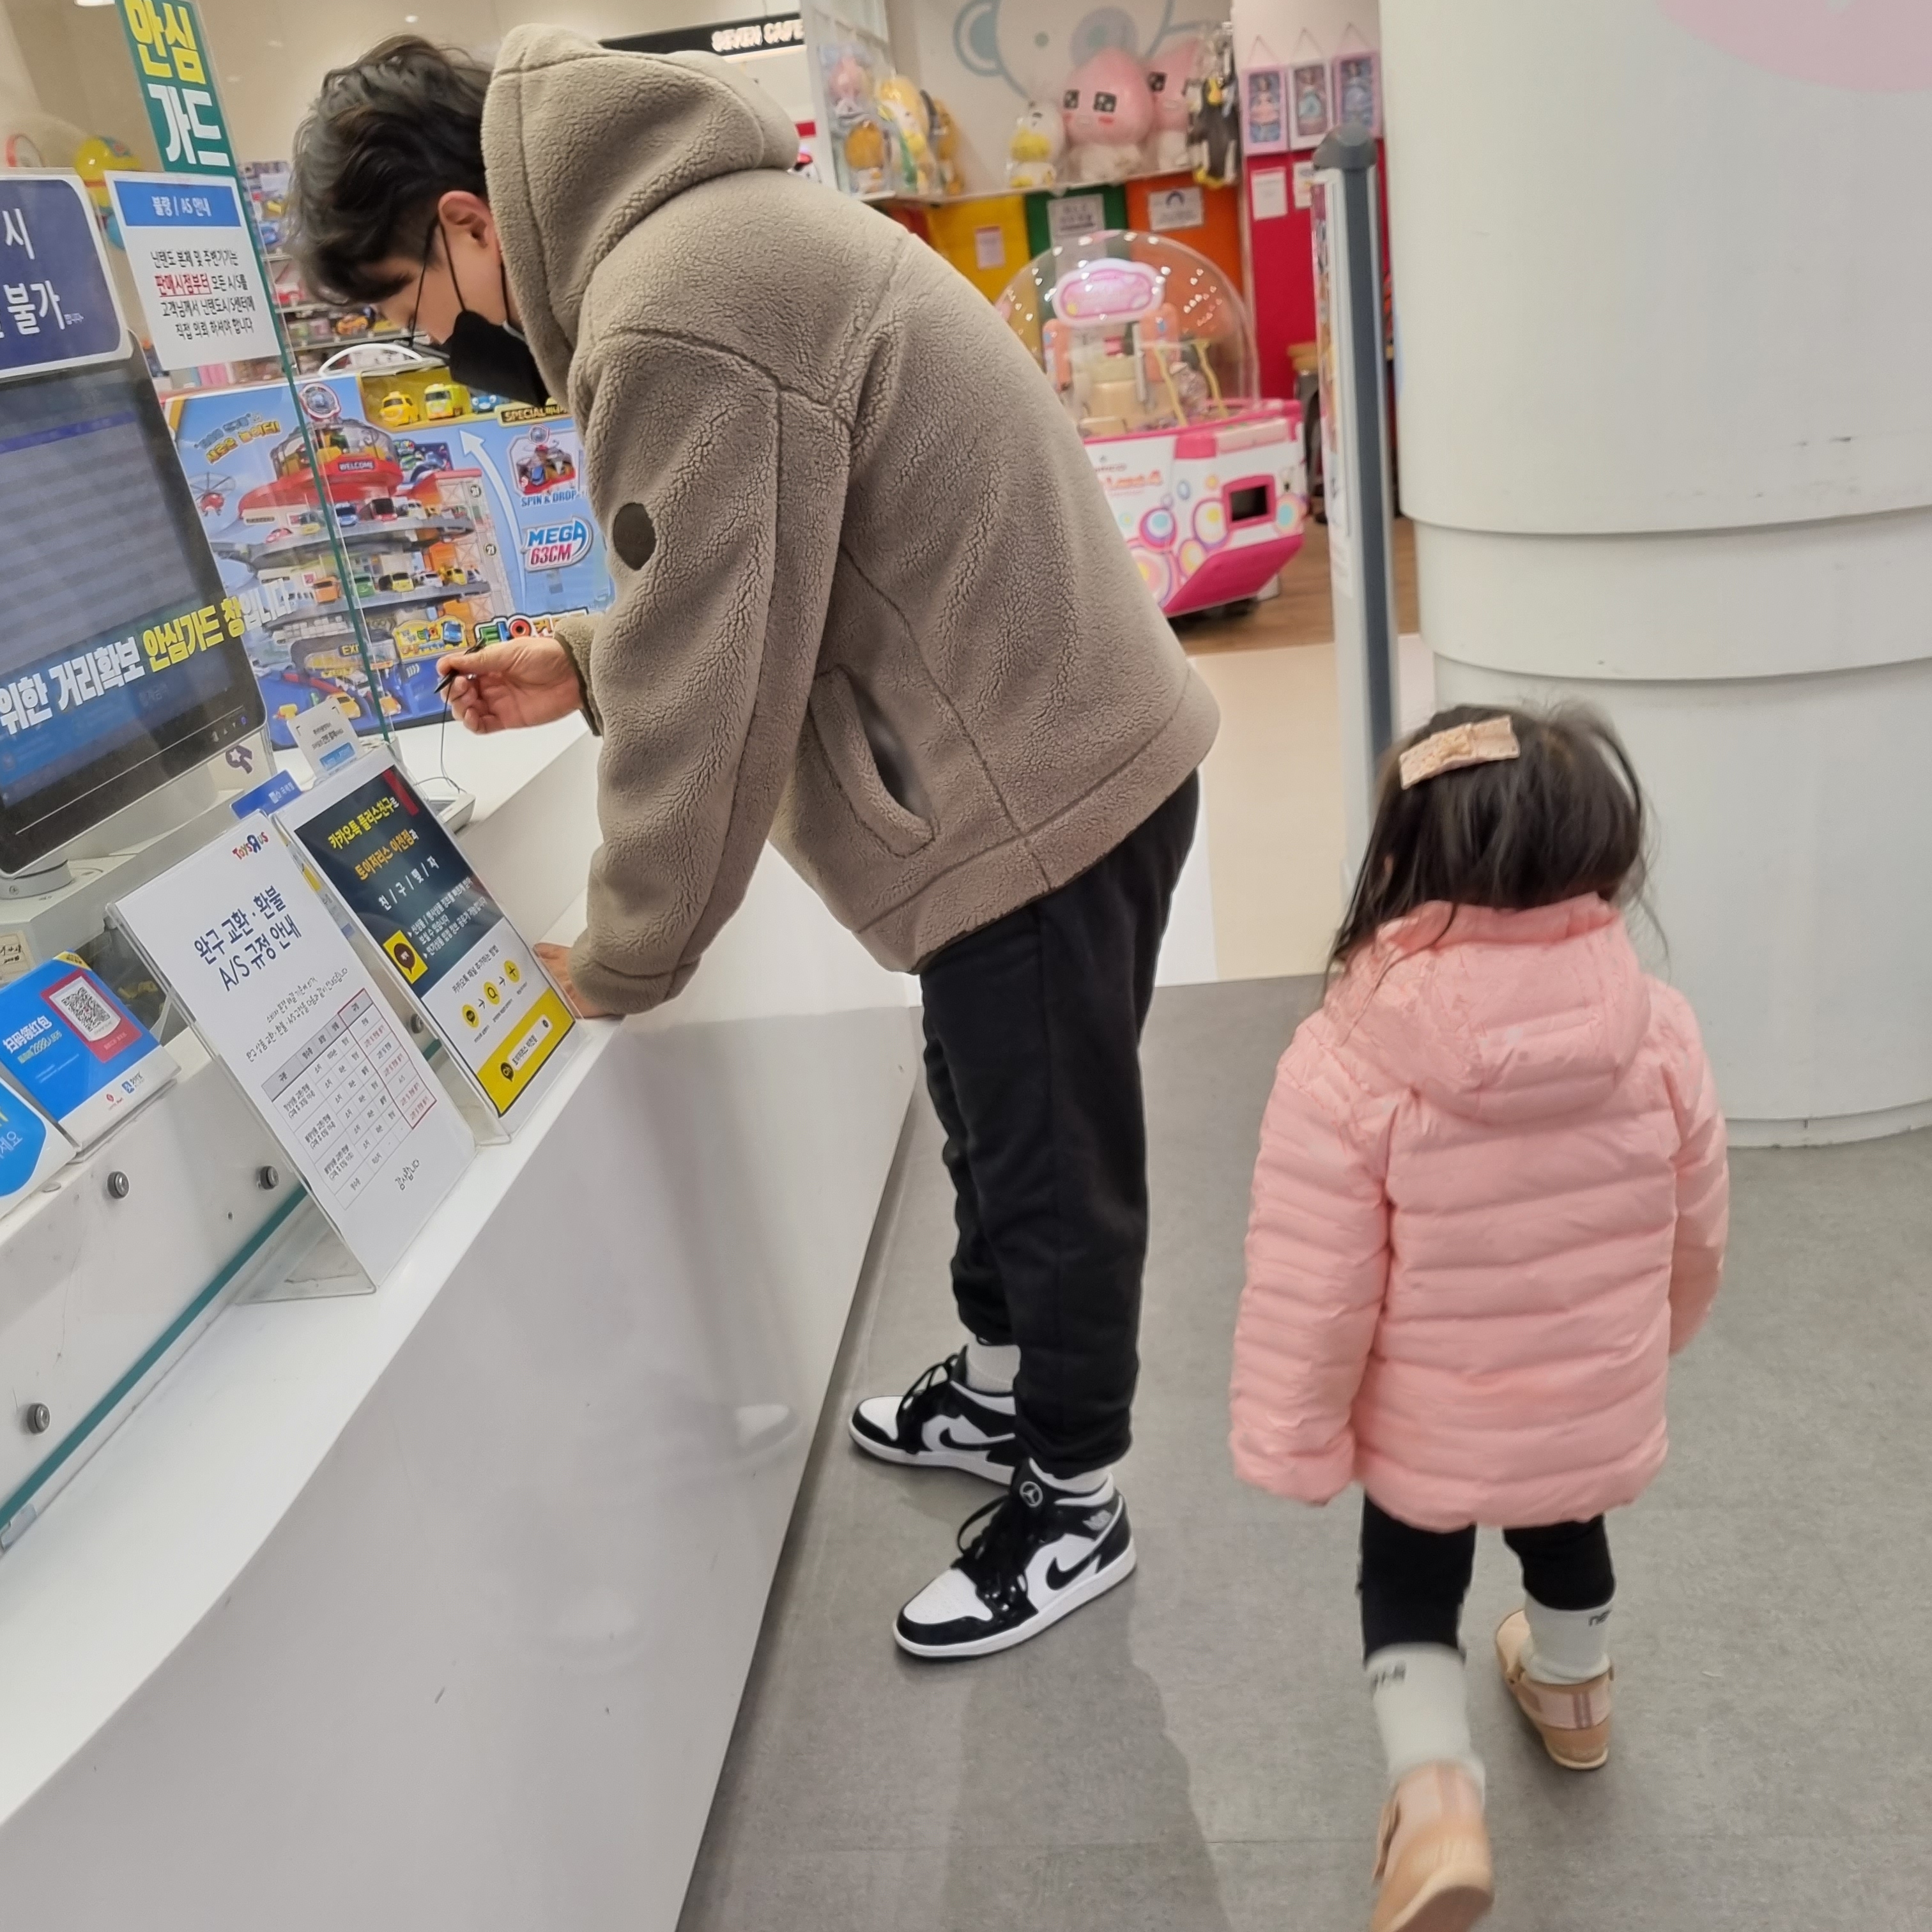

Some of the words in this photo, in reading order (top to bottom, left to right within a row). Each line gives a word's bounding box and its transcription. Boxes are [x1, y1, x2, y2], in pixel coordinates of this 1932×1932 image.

[125, 0, 207, 84] 안심
[711, 25, 762, 52] SEVEN
[148, 83, 231, 167] 가드
[151, 251, 176, 268] 닌텐도
[193, 250, 203, 266] 및
[155, 274, 210, 295] 판매시점부터
[211, 275, 226, 291] 모든
[161, 300, 199, 317] 고객님께서
[175, 323, 192, 339] 직접
[210, 319, 231, 334] 하셔야
[232, 318, 252, 334] 합니다
[505, 407, 546, 422] SPECIAL
[339, 460, 374, 471] WELCOME
[521, 494, 542, 507] SPIN
[552, 490, 577, 503] DROP
[528, 521, 586, 547] MEGA
[531, 544, 572, 565] 63CM
[49, 636, 146, 711] 거리확보
[142, 605, 225, 673] 안심가드
[328, 819, 363, 850] 카카오톡
[356, 797, 399, 831] 플러스친구로
[390, 829, 419, 853] 이천점과
[395, 882, 407, 897] 구
[427, 855, 440, 869] 자
[194, 929, 225, 965] 완구
[221, 908, 254, 944] 교환
[253, 885, 286, 920] 환불
[218, 954, 250, 992] A/S
[244, 933, 276, 970] 규정
[270, 914, 302, 949] 안내
[3, 1015, 52, 1054] 扫码领红包
[395, 1159, 420, 1192] 감사합니다
